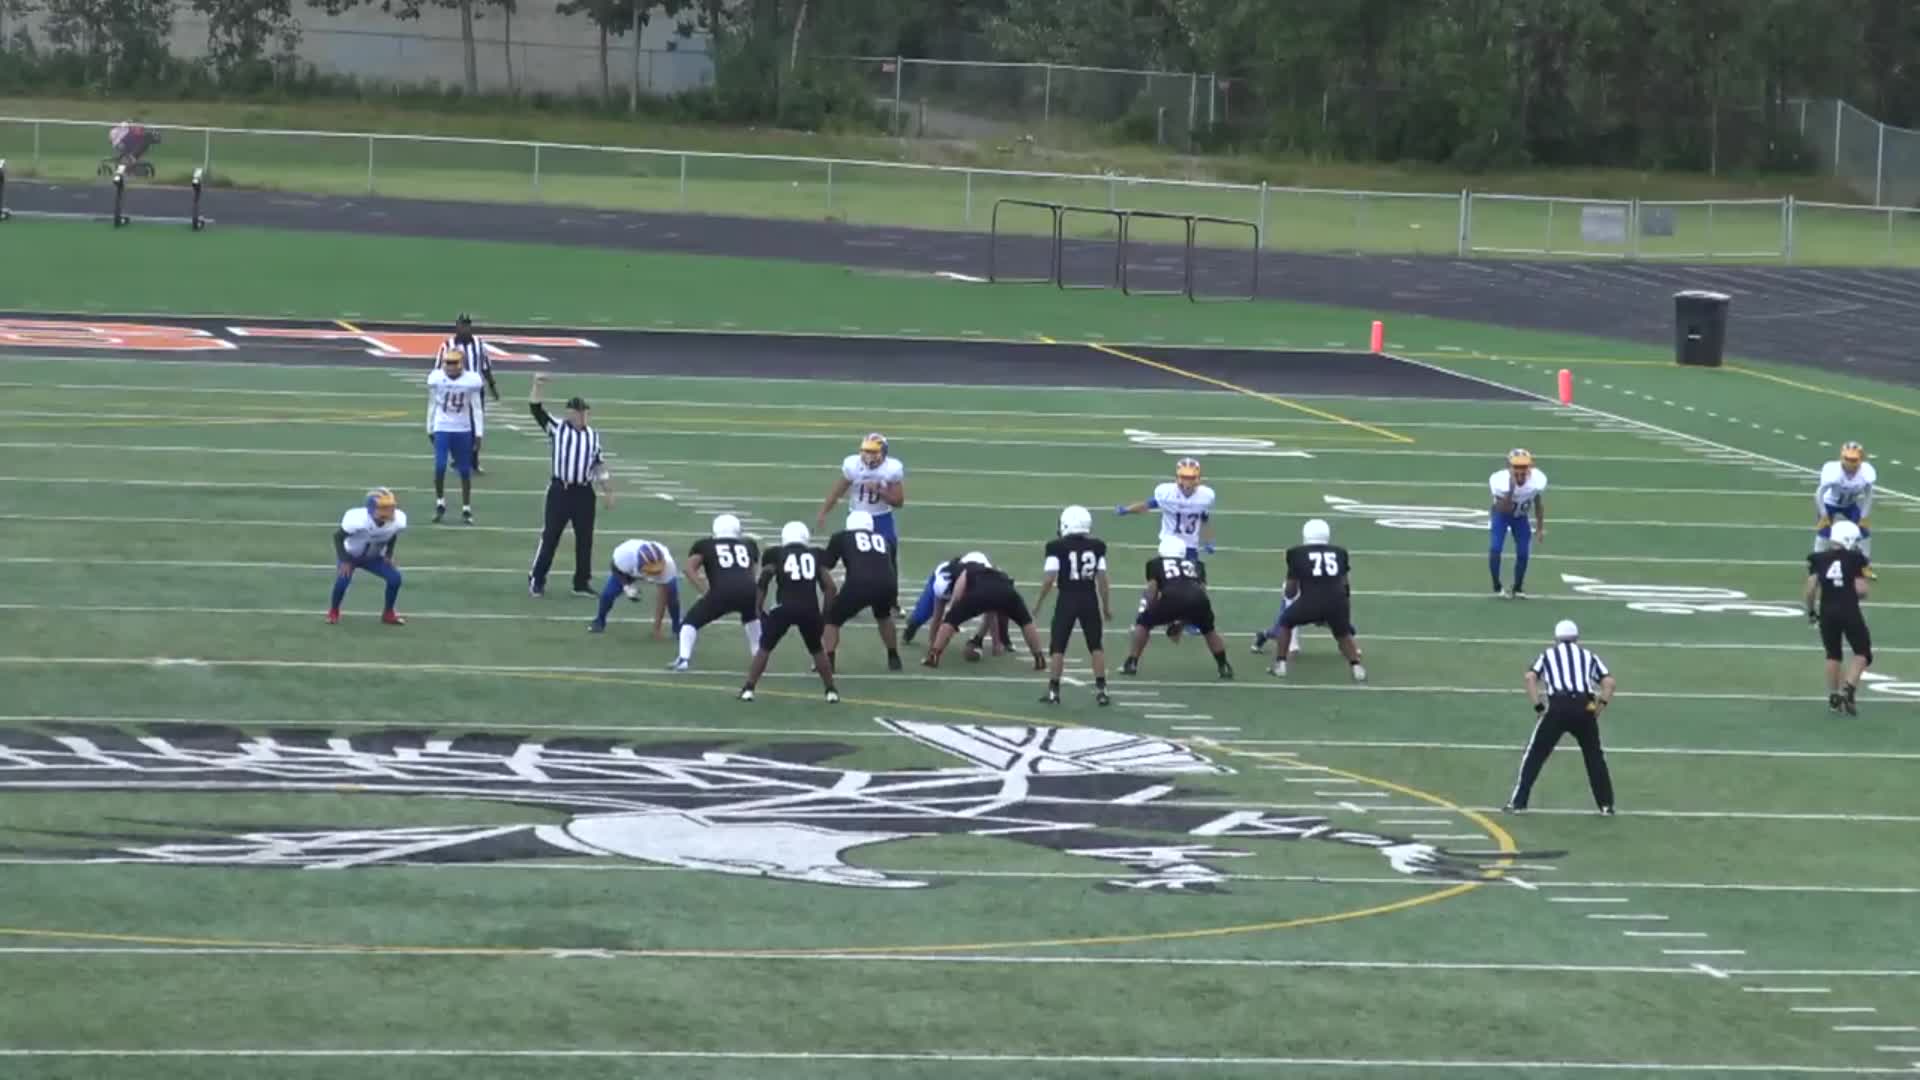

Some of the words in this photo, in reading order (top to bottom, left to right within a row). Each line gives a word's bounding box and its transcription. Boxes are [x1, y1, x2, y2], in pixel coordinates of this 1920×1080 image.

[443, 391, 465, 414] 14
[1174, 511, 1200, 535] 13
[716, 544, 750, 568] 58
[784, 553, 815, 580] 40
[1068, 550, 1096, 580] 12
[1308, 552, 1338, 577] 75
[1162, 559, 1197, 579] 53
[1826, 560, 1844, 587] 4
